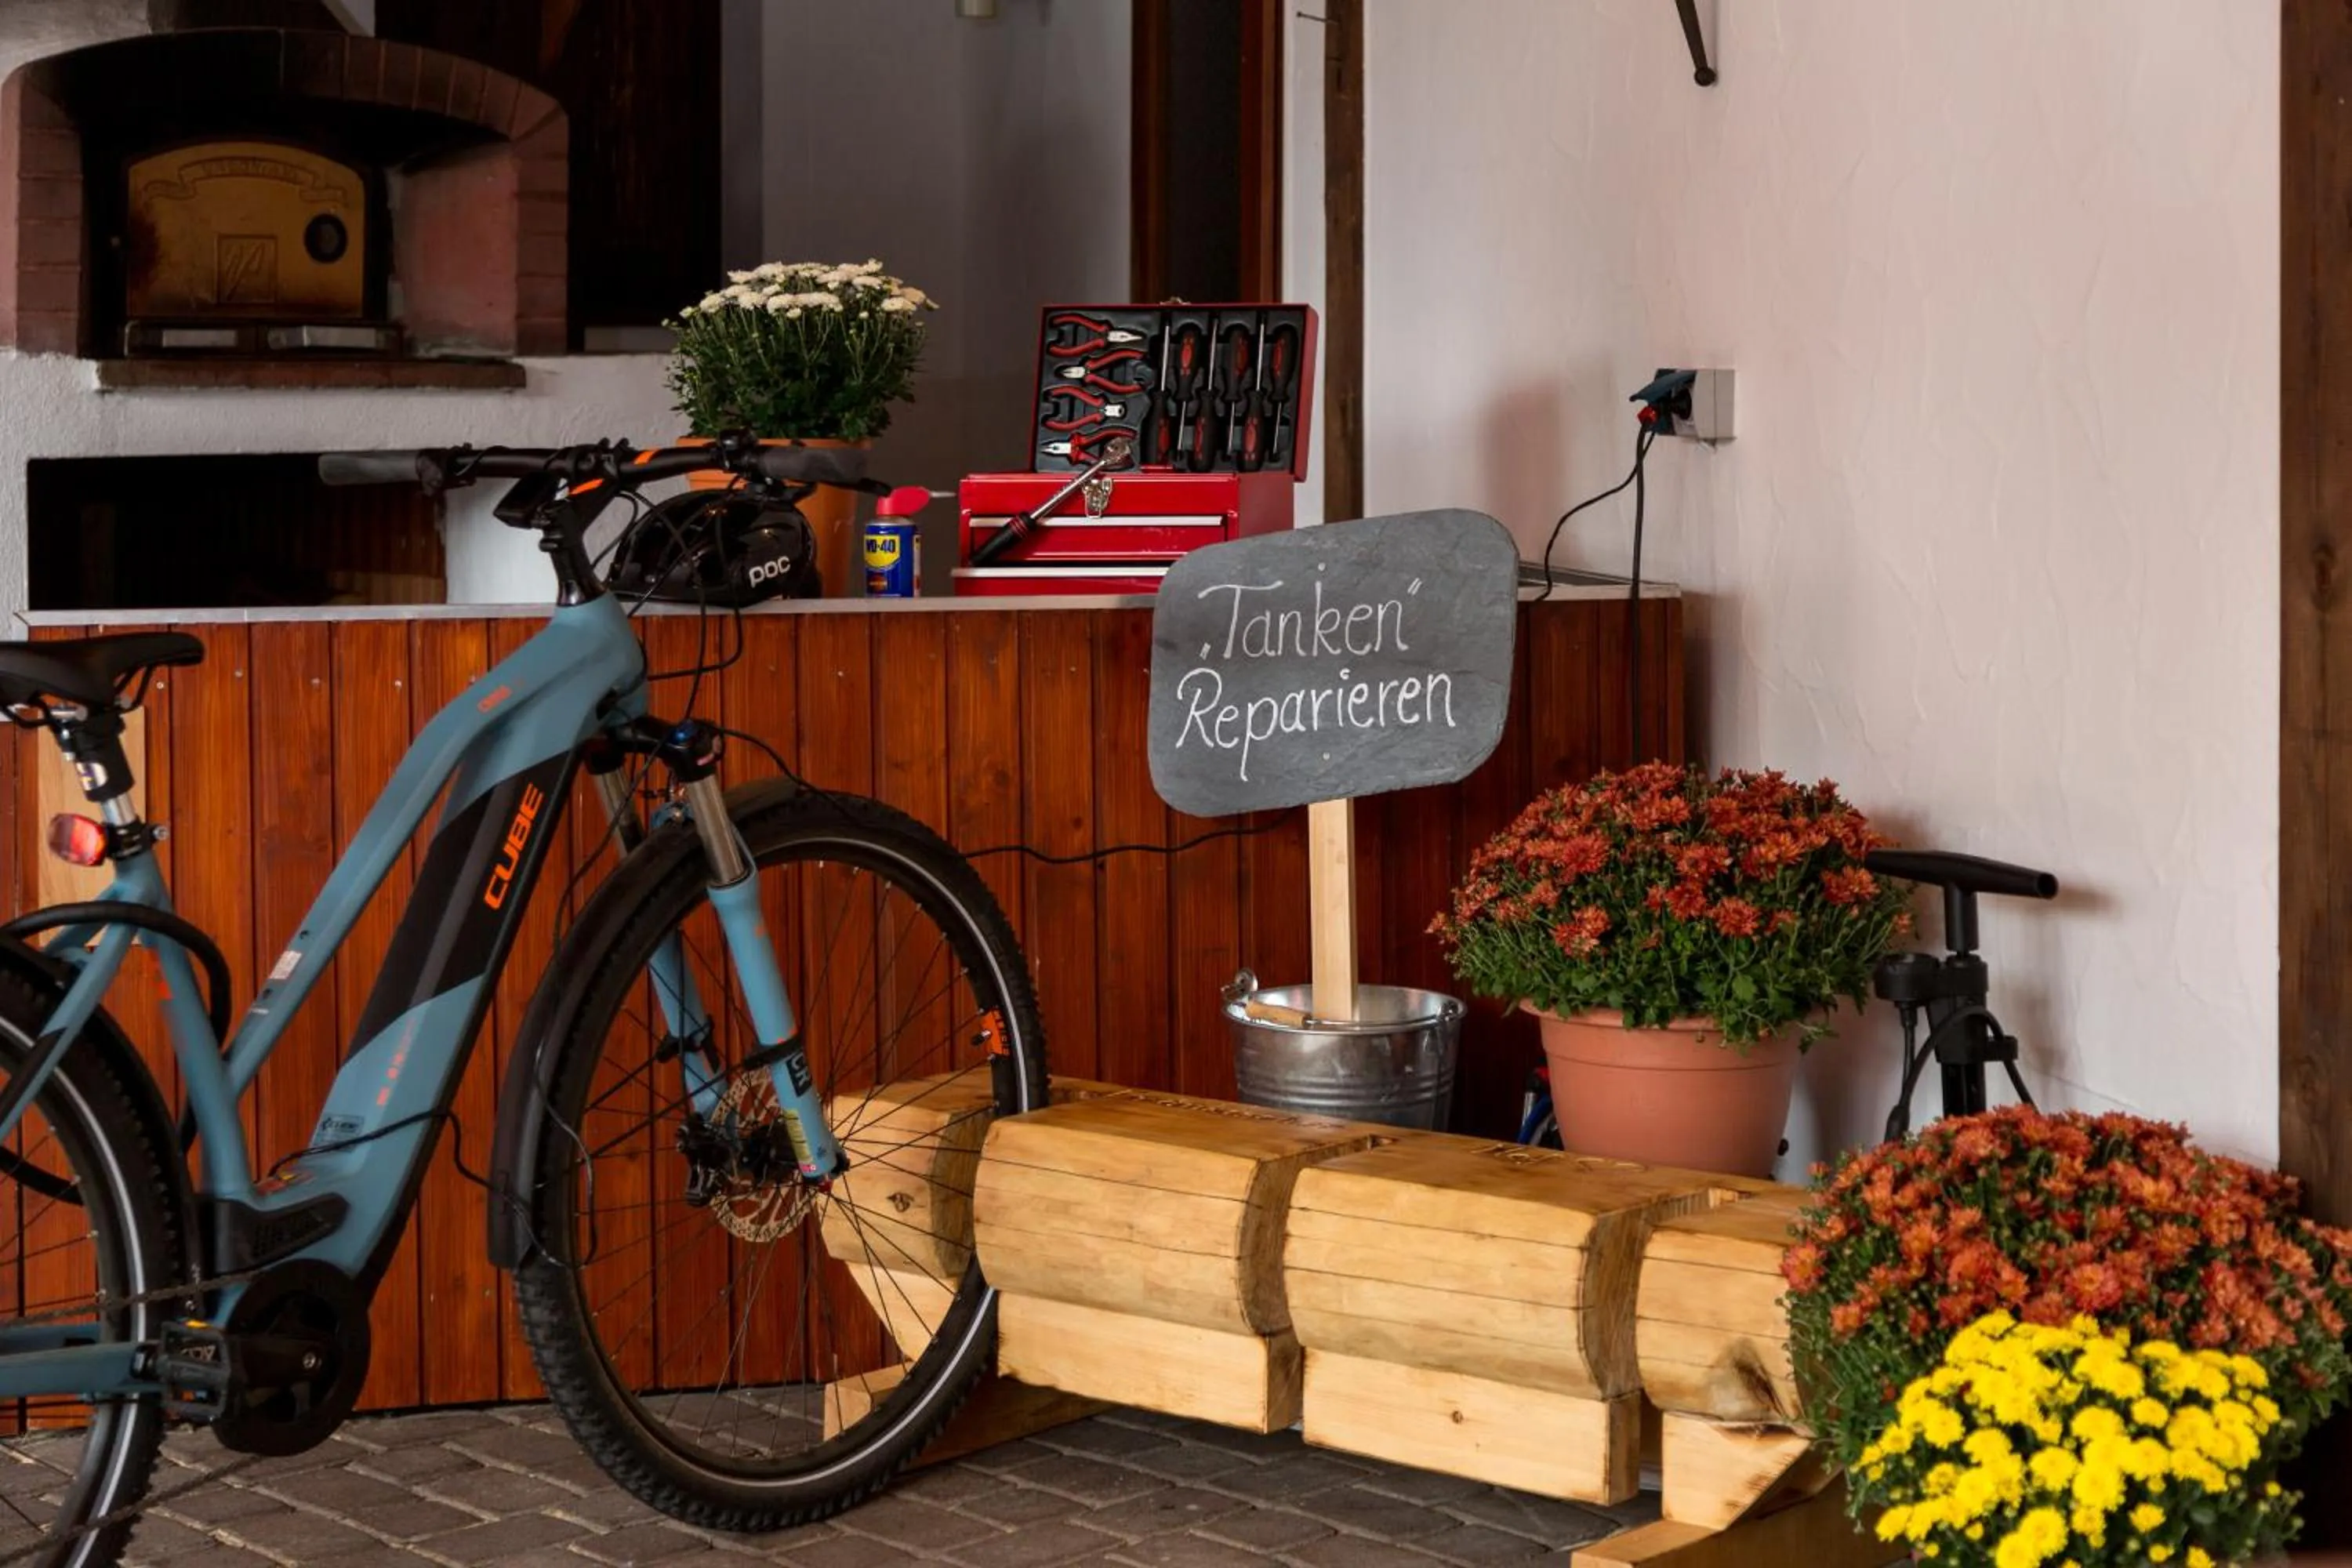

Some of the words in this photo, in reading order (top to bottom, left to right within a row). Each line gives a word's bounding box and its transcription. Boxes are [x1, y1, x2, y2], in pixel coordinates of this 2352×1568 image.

[866, 538, 896, 554] WD-40
[1176, 668, 1457, 782] Reparieren
[484, 782, 545, 910] CUBE
